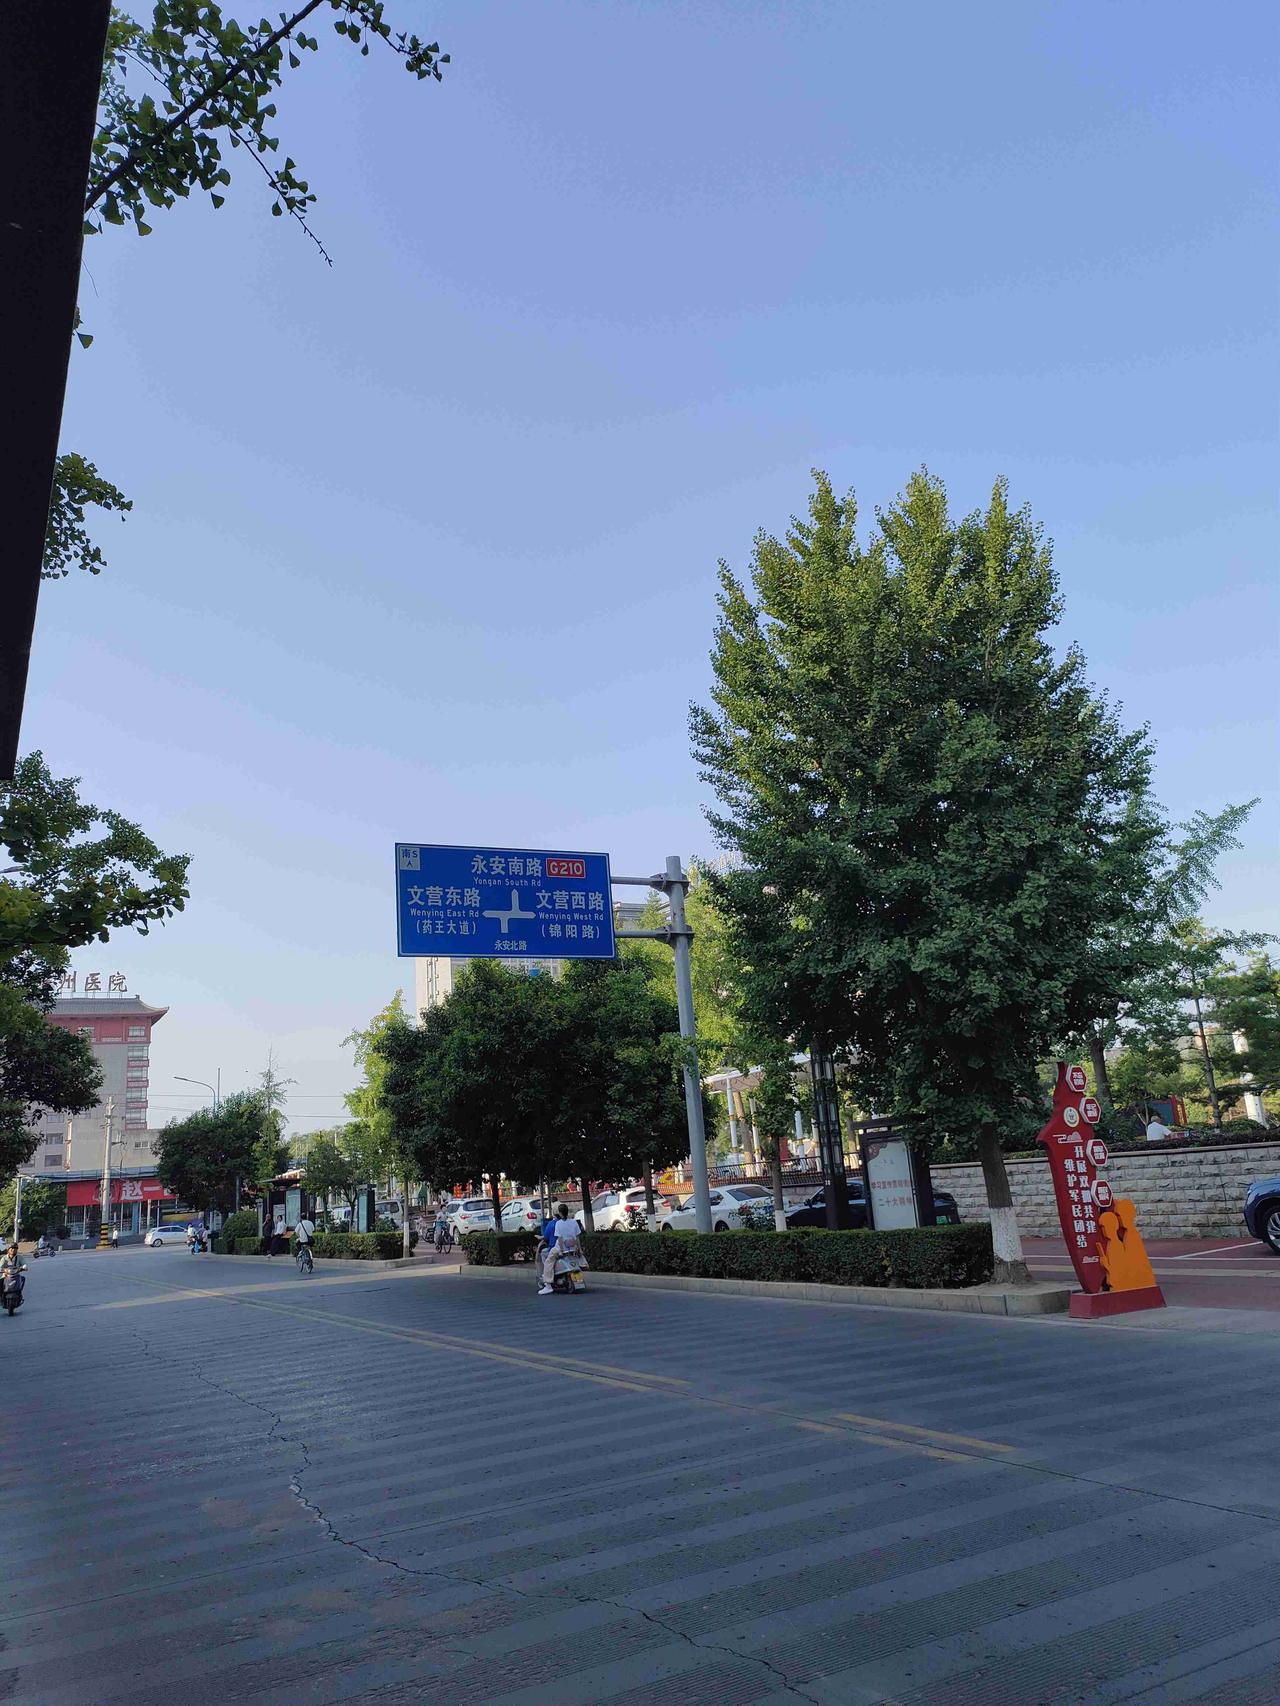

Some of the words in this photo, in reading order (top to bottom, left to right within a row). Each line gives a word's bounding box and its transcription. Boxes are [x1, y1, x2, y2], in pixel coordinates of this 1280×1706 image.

[471, 854, 542, 877] 永安南路
[549, 861, 583, 875] G210
[473, 877, 502, 887] Yongan
[505, 878, 528, 886] South
[531, 879, 541, 887] Rd
[407, 885, 480, 907] 文营东路
[535, 889, 604, 911] 文营西路
[410, 908, 444, 919] Wenying
[447, 909, 466, 917] East
[469, 910, 479, 918] Rd
[539, 912, 571, 922] Wenying
[573, 912, 592, 920] West
[594, 913, 604, 921] Rd
[494, 940, 527, 951] 永安北路
[1064, 1159, 1087, 1248] 维护军民团结
